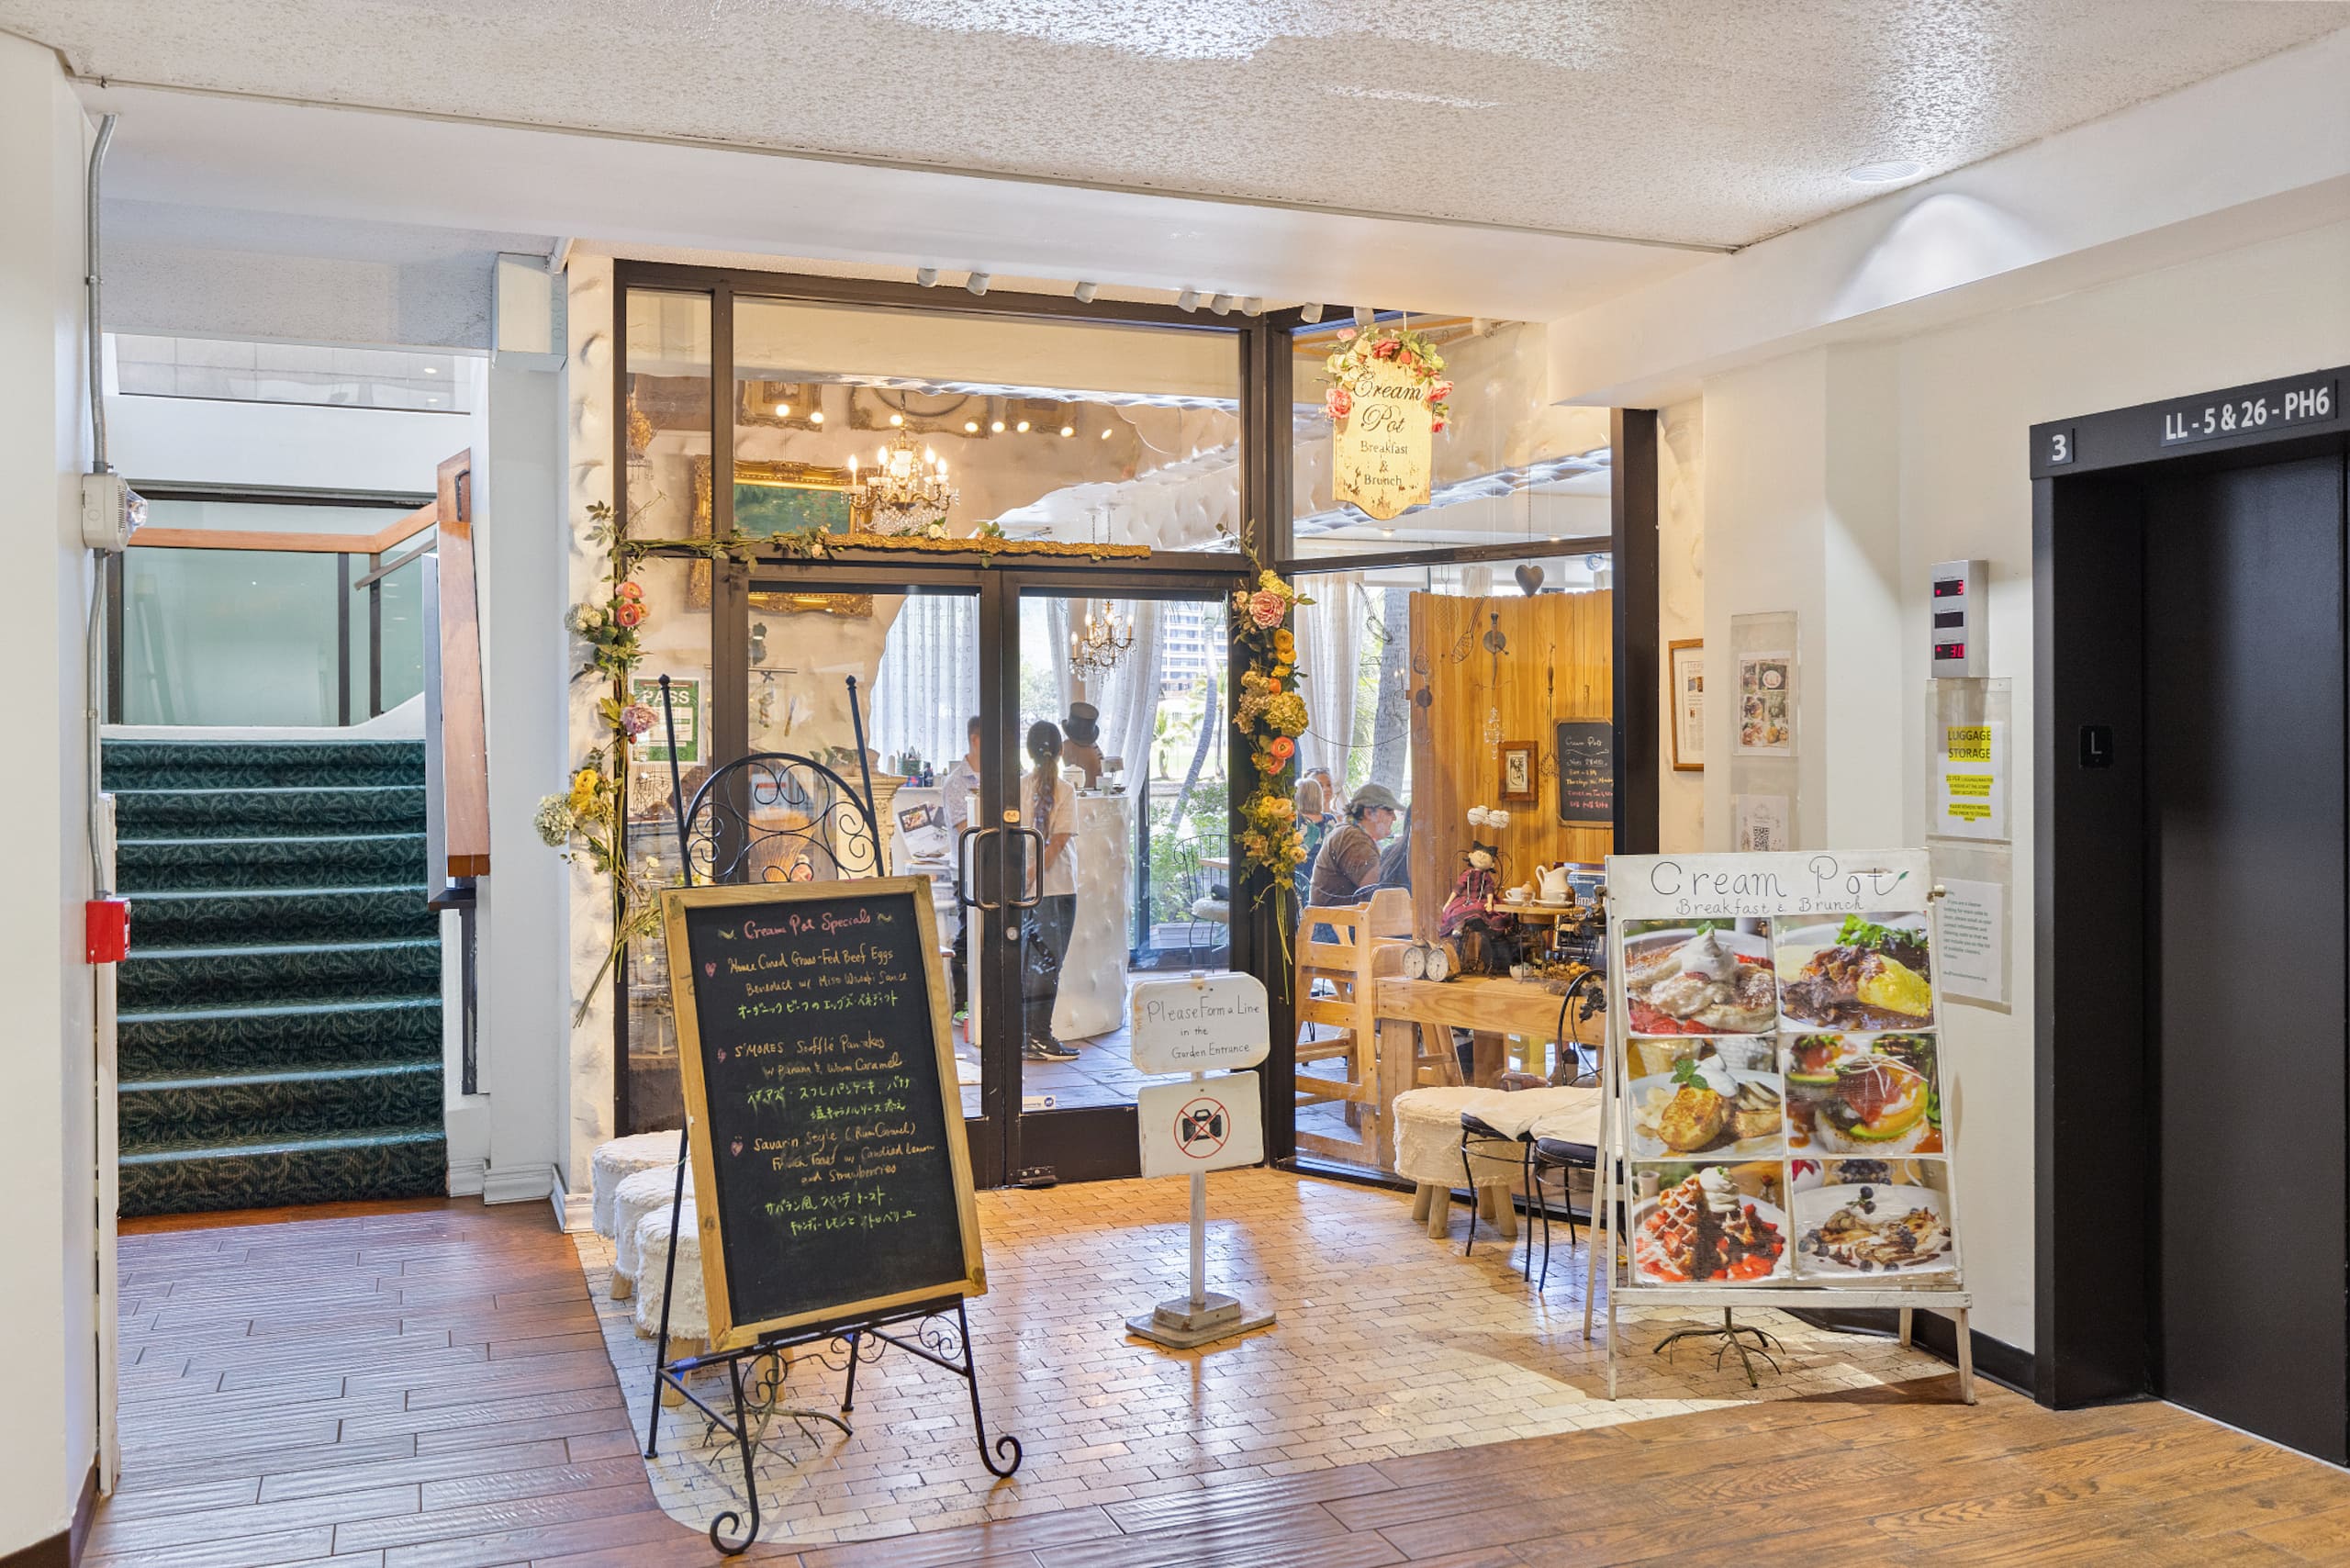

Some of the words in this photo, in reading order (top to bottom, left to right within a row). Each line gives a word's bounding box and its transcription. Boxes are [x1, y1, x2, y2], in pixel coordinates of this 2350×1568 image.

[1351, 368, 1424, 400] Cream
[1361, 403, 1405, 434] Pot
[1360, 440, 1408, 455] Breakfast
[2052, 434, 2067, 462] 3
[1379, 460, 1389, 474] &
[1364, 475, 1403, 487] Brunch
[1957, 581, 1964, 594] 3
[642, 689, 690, 704] PASS
[1947, 730, 1991, 741] LUGGAGE
[2091, 731, 2103, 755] L
[1948, 747, 1991, 758] STORAGE
[1651, 861, 1786, 898] Cream
[1809, 856, 1908, 896] Pot
[1676, 898, 1770, 915] Breakfast
[1799, 895, 1864, 913] Brunch
[744, 920, 787, 940] Cream
[789, 914, 815, 936] Pot
[822, 908, 871, 936] Specials
[842, 942, 867, 965] Beef
[870, 946, 894, 966] Eggs
[745, 979, 793, 997] Benedict
[819, 974, 842, 988] Miso
[878, 970, 909, 985] Sauce
[1147, 1000, 1197, 1023] Please
[1200, 996, 1225, 1018] Form
[1227, 1006, 1234, 1014] a
[1237, 995, 1260, 1014] Line
[1181, 1026, 1190, 1036] in
[1194, 1027, 1209, 1036] the
[1172, 1046, 1206, 1059] Garden
[1209, 1043, 1250, 1056] Entrance
[827, 1063, 853, 1074] Warm
[855, 1051, 903, 1072] Caramel
[806, 1128, 837, 1152] Style
[861, 1146, 903, 1160] Candied
[800, 1171, 822, 1184] and
[830, 1163, 897, 1182] Strawberries
